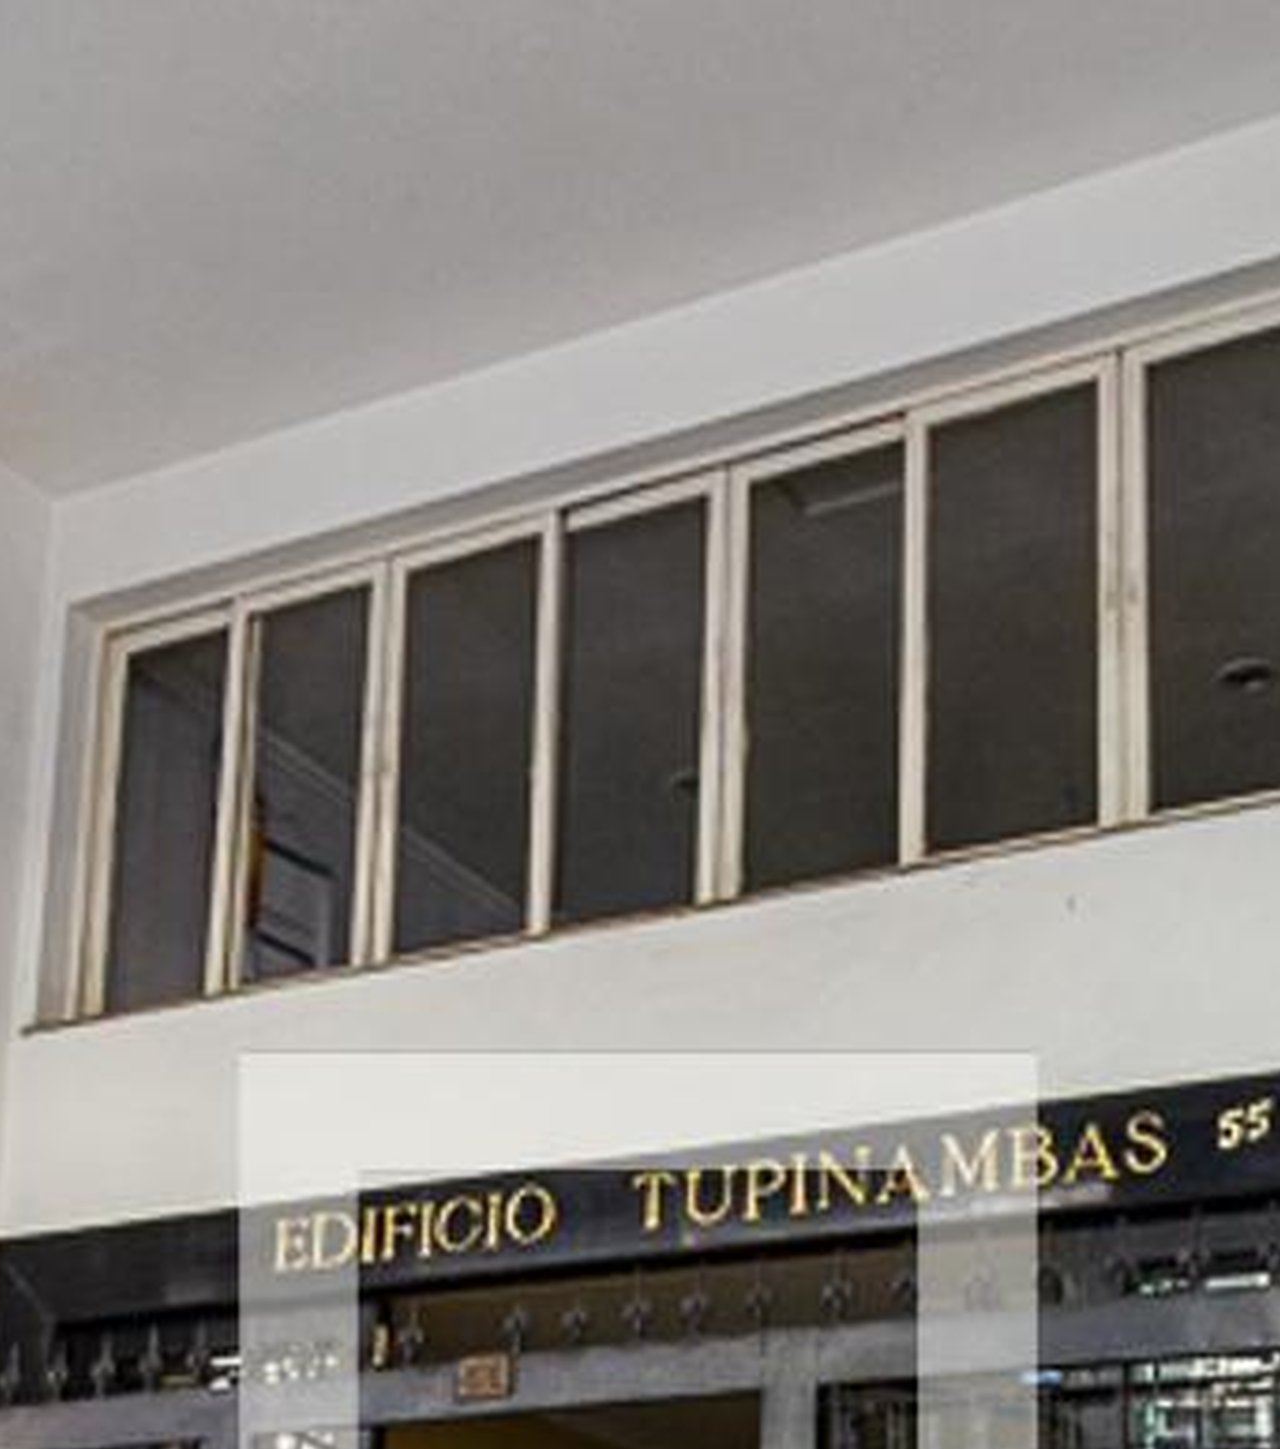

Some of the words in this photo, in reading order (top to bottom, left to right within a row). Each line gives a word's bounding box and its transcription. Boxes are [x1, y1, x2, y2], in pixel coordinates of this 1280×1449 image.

[274, 1182, 558, 1273] EDIFICIO
[633, 1109, 1169, 1233] TUPINAMBAS
[1216, 1096, 1277, 1151] 55
